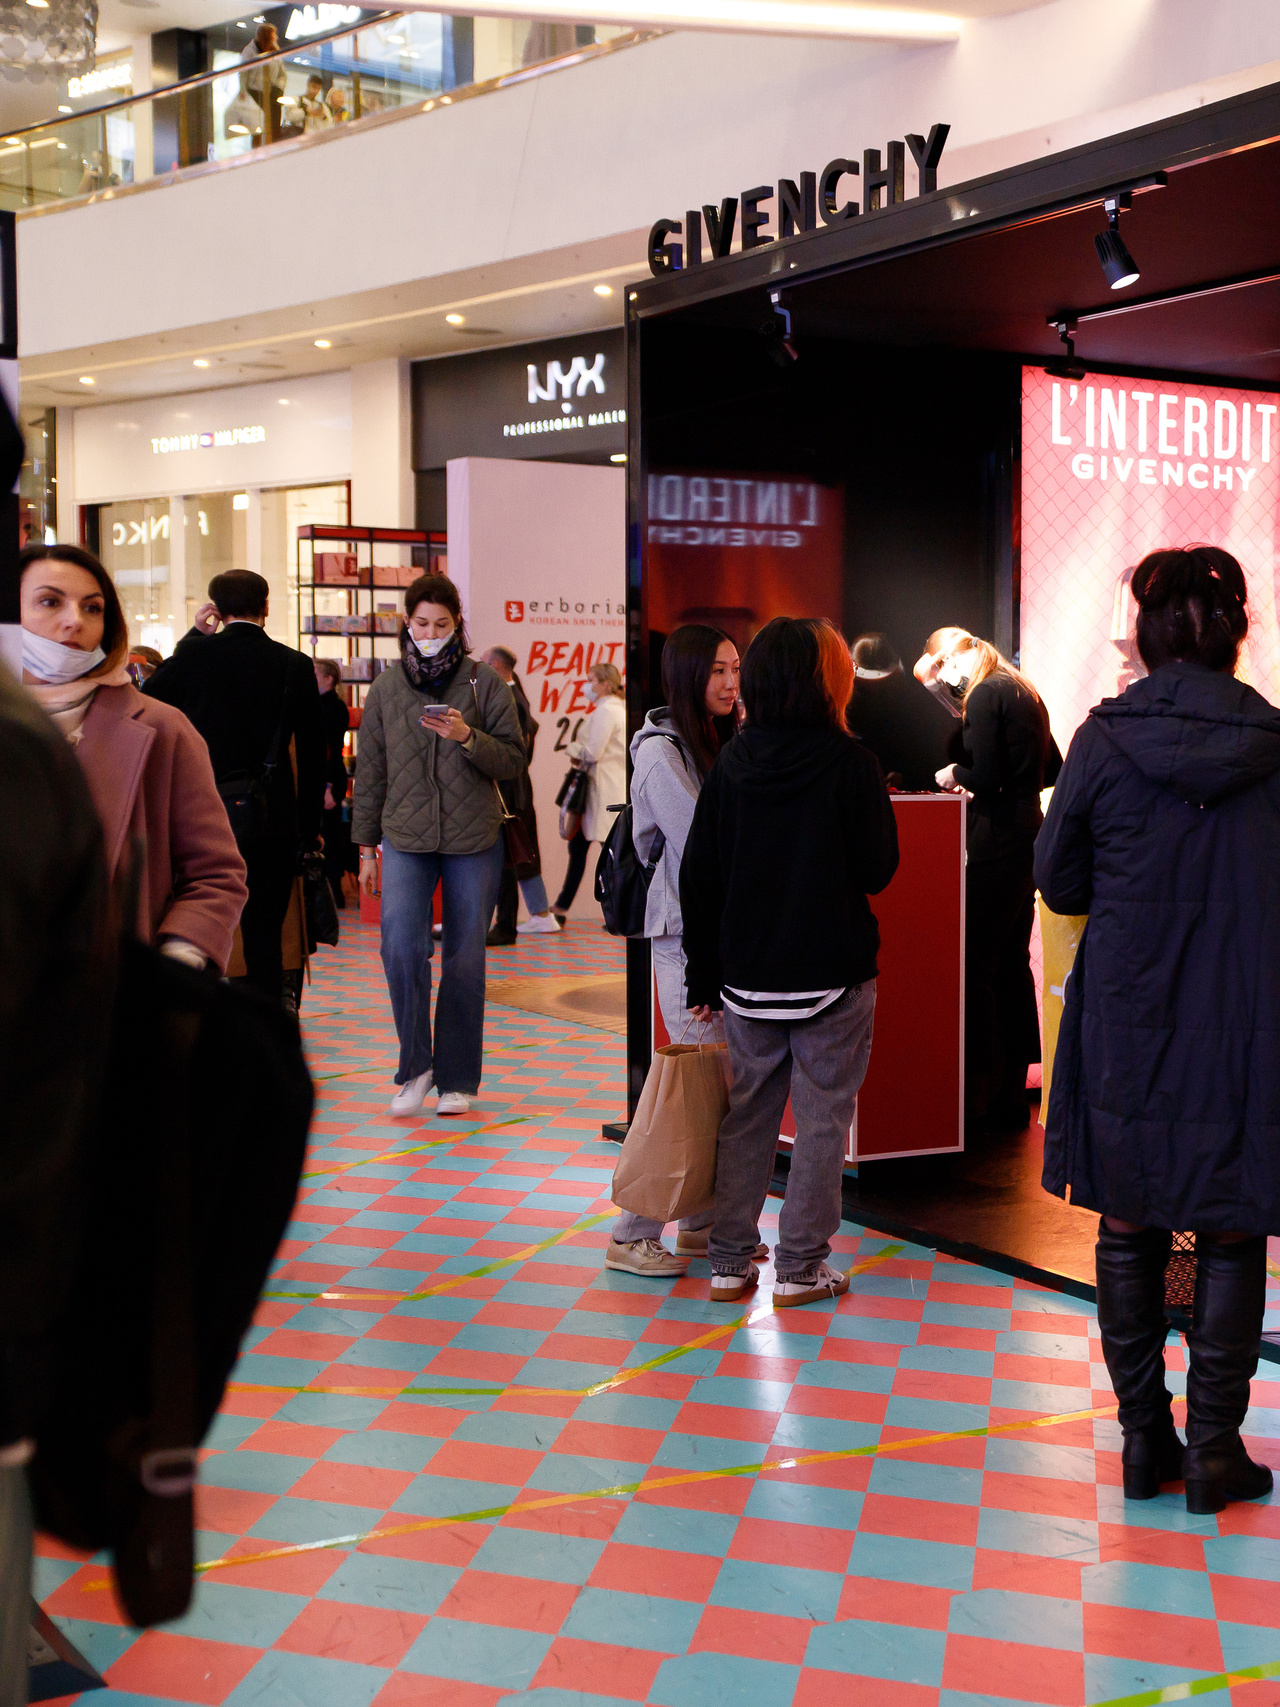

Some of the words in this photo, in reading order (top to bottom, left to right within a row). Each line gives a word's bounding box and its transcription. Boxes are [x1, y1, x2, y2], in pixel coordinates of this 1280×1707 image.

[647, 123, 951, 277] GIVENCHY
[527, 353, 605, 403] NYX
[503, 415, 584, 437] PROFESSIONAL
[588, 409, 626, 426] MAKEU
[1051, 382, 1277, 463] L'INTERDIT
[151, 433, 199, 454] TOMMY
[1071, 453, 1256, 492] GIVENCHY
[529, 597, 626, 614] erboria
[529, 616, 569, 626] KOREAN
[573, 619, 596, 627] SKIN
[600, 619, 625, 628] THER
[526, 640, 627, 676] BEAUT
